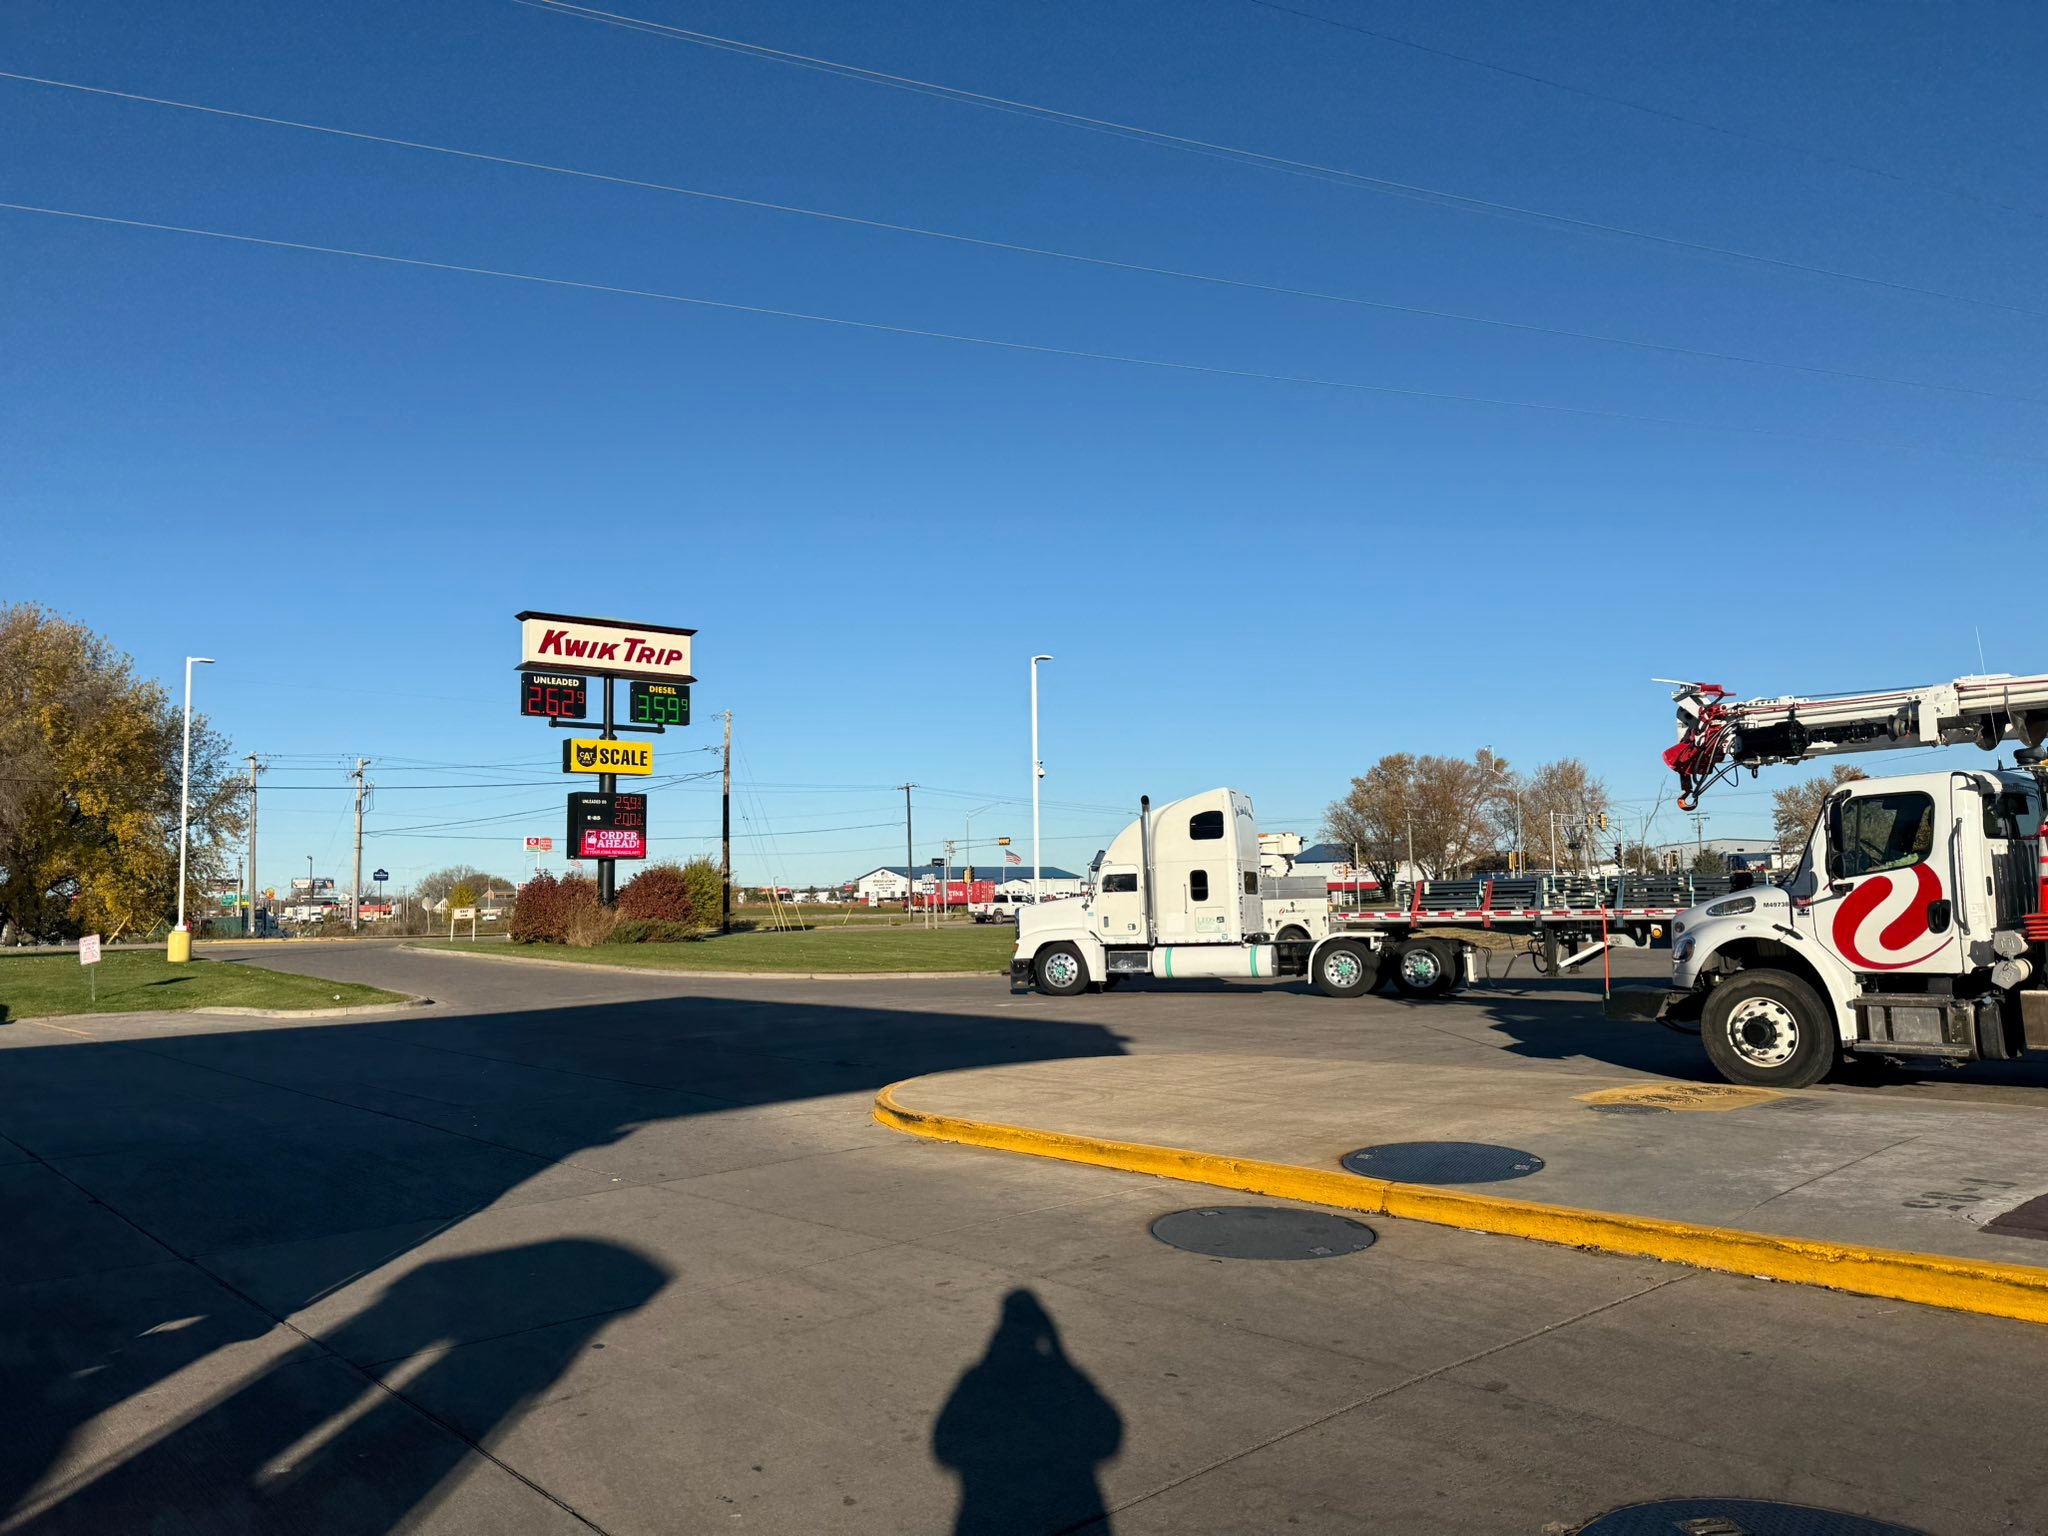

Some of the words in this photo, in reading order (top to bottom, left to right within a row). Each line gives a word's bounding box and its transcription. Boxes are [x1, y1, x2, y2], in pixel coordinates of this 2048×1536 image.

[538, 629, 621, 660] KWIK
[623, 637, 683, 665] TRIP
[533, 676, 580, 687] UNLEADED
[649, 685, 677, 695] DIESEL
[579, 751, 594, 761] CAT
[600, 748, 648, 766] SCALE
[600, 831, 638, 840] ORDER
[597, 839, 640, 849] AHEAD!
